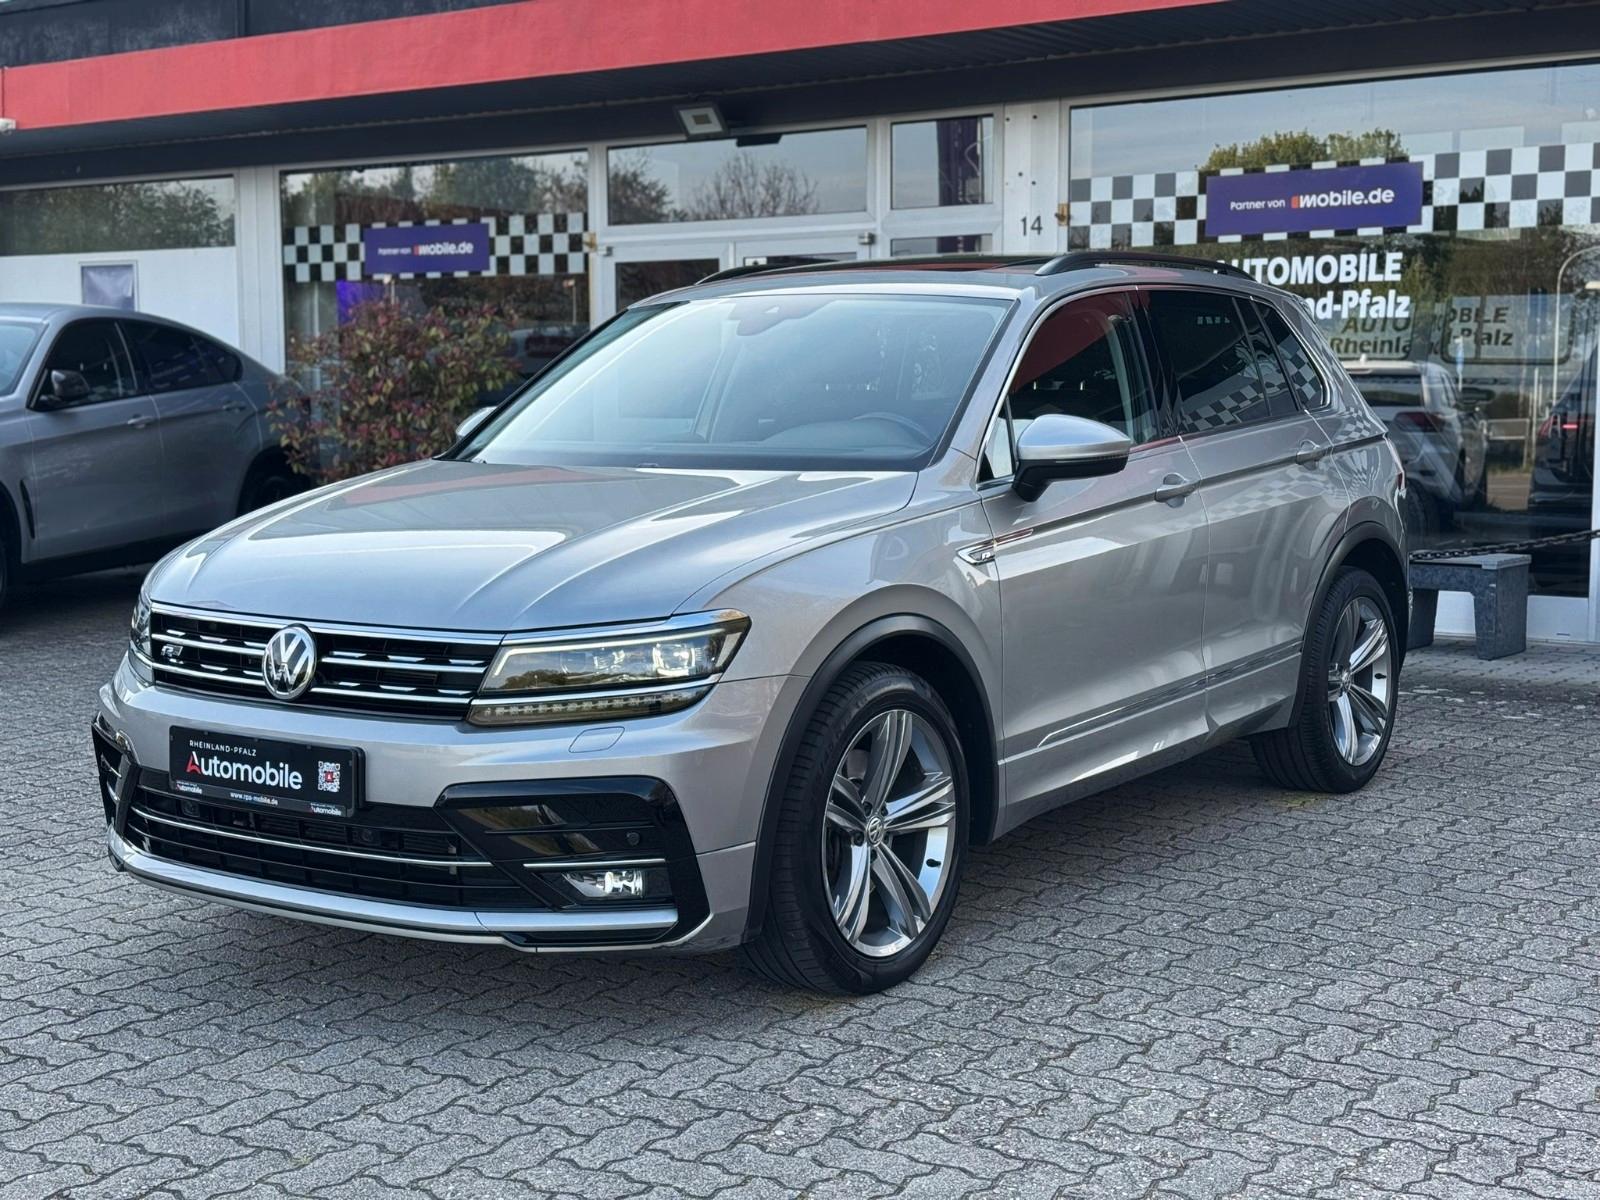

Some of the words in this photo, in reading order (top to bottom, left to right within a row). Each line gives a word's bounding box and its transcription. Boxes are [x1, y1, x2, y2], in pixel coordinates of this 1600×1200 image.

[1230, 199, 1266, 211] Partner
[1267, 198, 1286, 208] von
[1291, 187, 1395, 209] mobile.de
[1021, 215, 1043, 236] 14
[1216, 252, 1404, 286] TOMOBILE
[189, 739, 257, 757] RHEINLAND-PFALZ
[186, 750, 303, 790] Automobile
